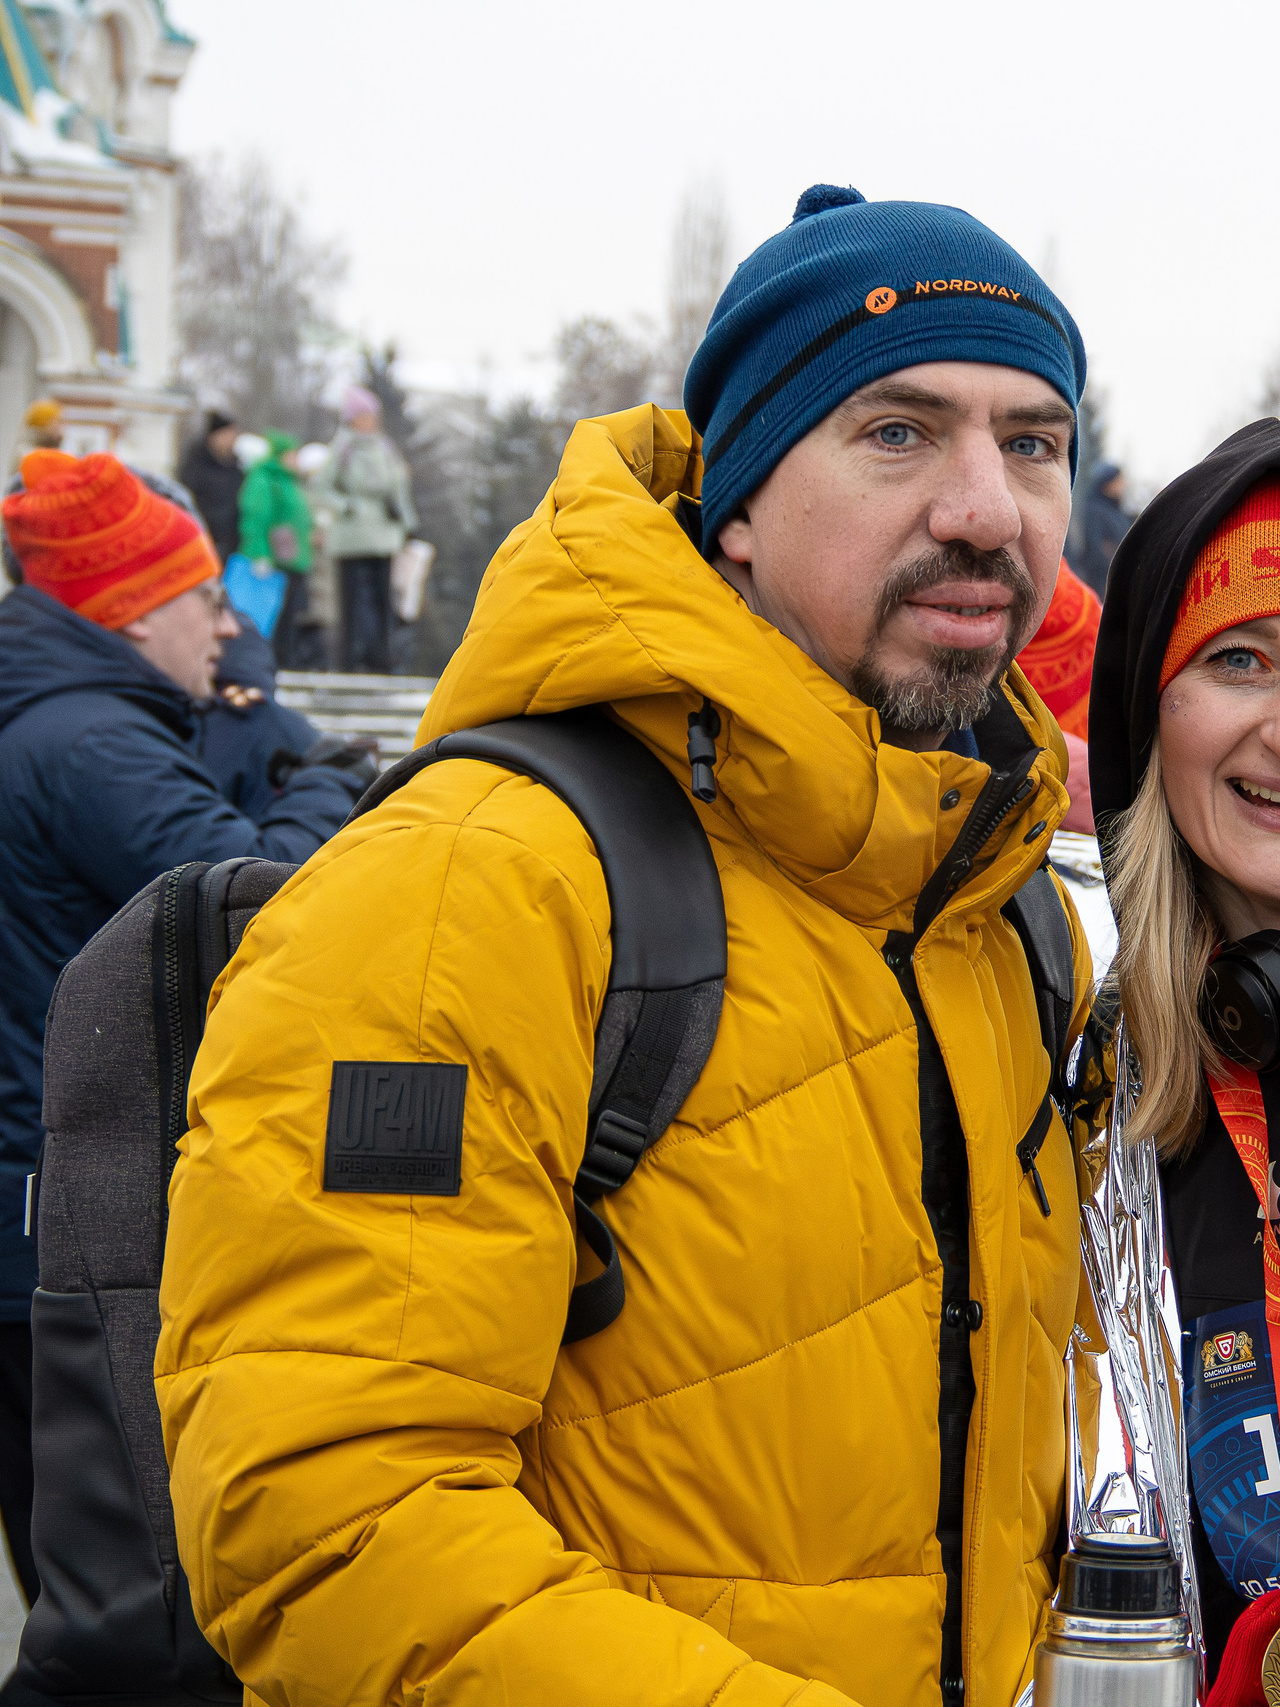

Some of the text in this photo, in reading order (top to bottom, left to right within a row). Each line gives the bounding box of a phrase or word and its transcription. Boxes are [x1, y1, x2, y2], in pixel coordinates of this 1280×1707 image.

[914, 279, 1021, 302] NORDWAY
[337, 1067, 451, 1154] UF4M
[1203, 1360, 1257, 1379] ОМСКИЙ БЕКОН
